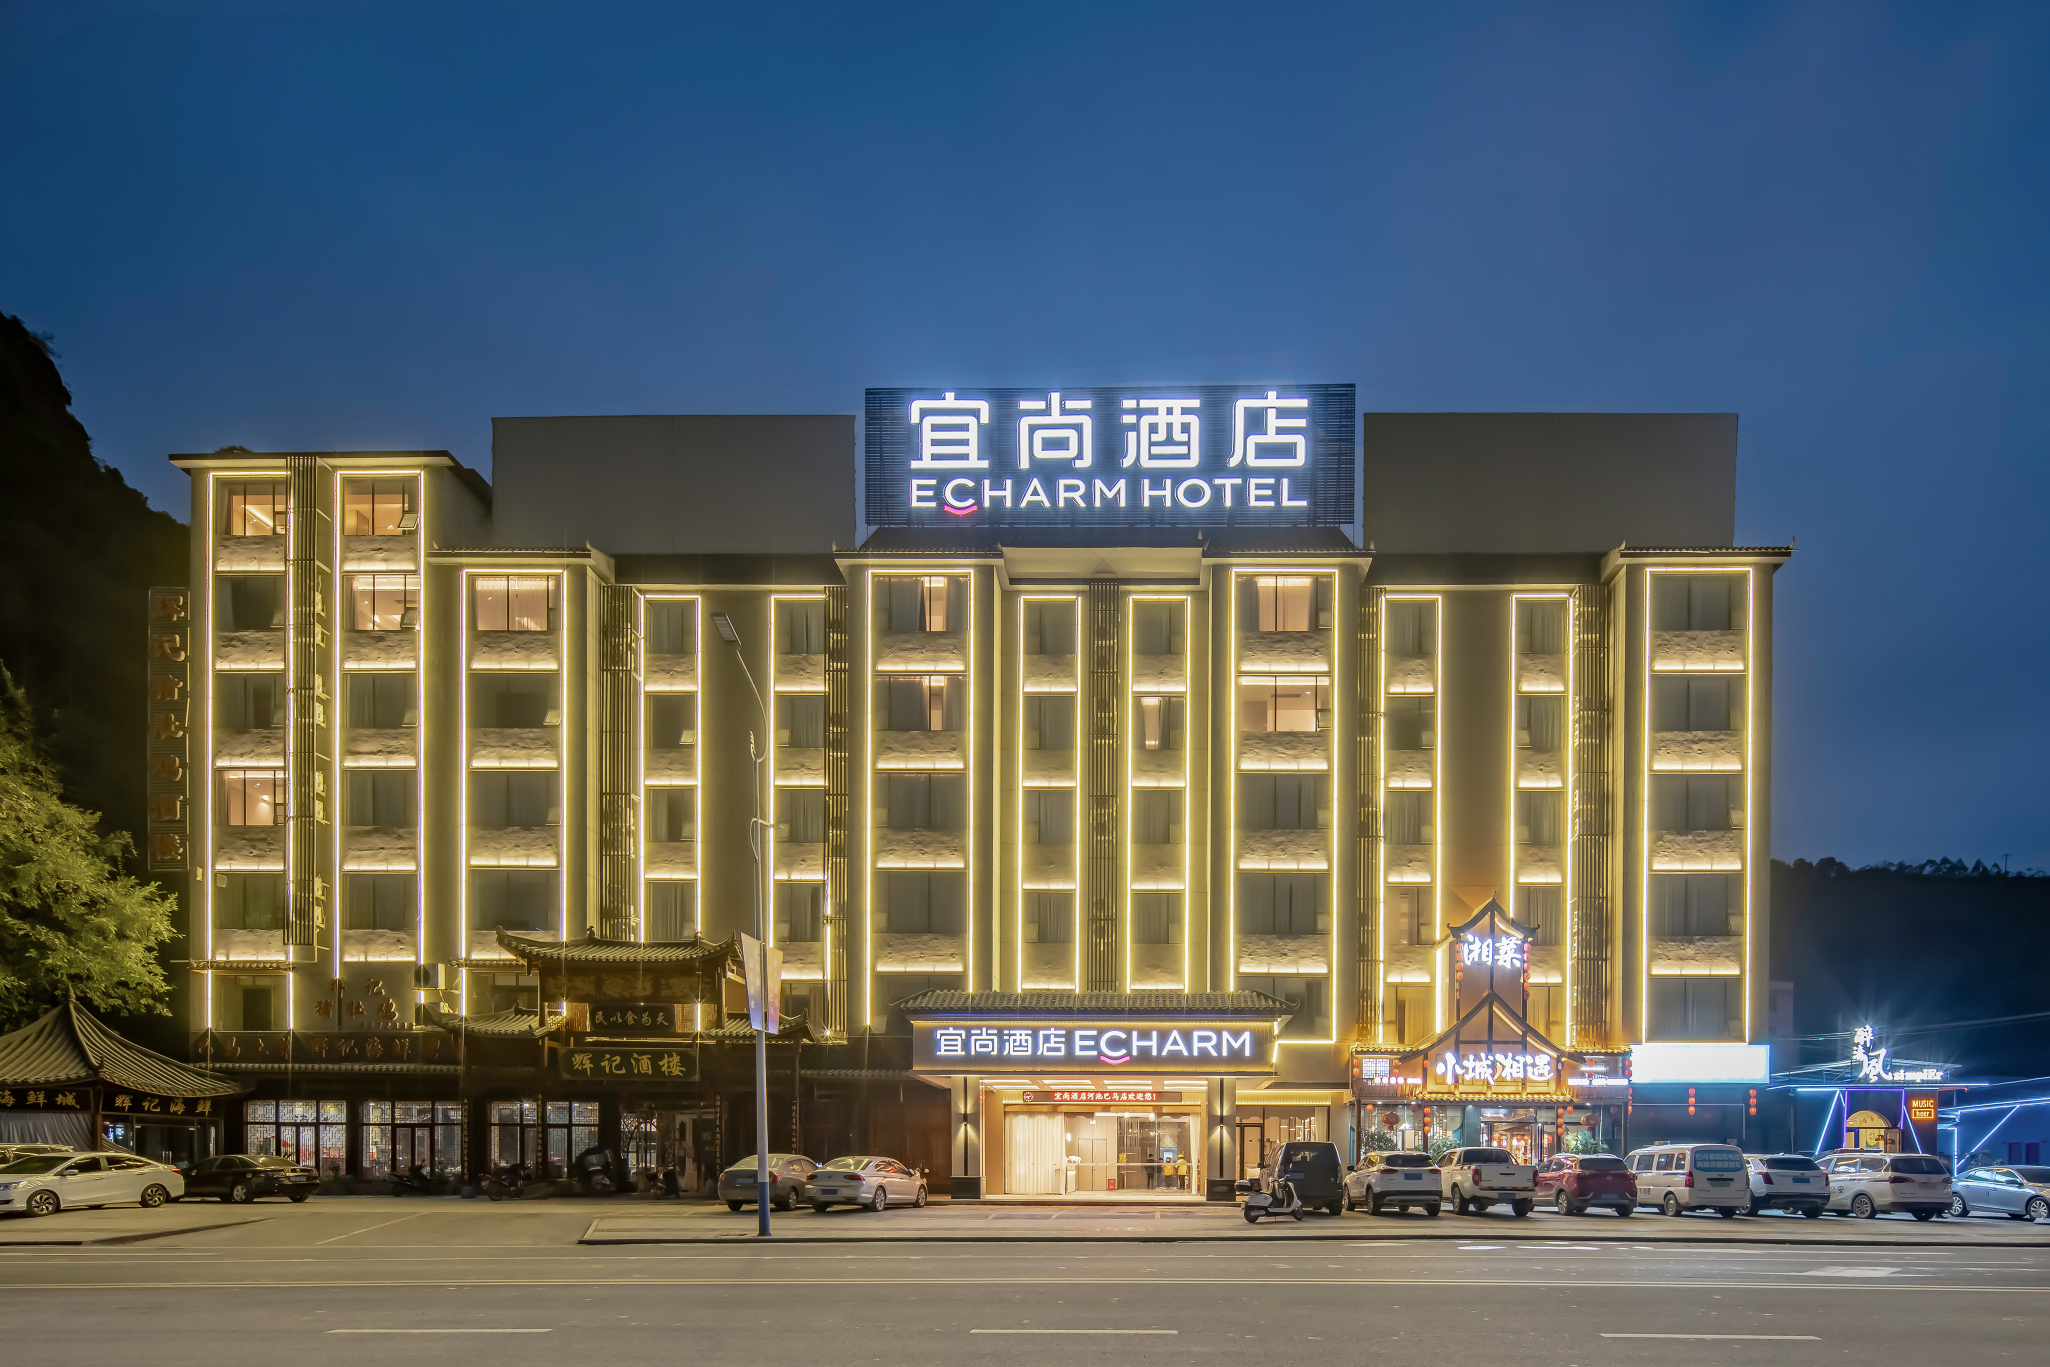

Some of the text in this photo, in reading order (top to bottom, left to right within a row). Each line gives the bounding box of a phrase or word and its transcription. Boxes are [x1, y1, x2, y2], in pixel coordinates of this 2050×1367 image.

[909, 390, 1309, 470] 宜尚酒店
[909, 477, 1309, 509] ECHARM HOTEL
[1463, 933, 1523, 969] 湘菜
[314, 998, 399, 1021] 猪肚鸡
[595, 1010, 670, 1026] 民以食为天
[935, 1026, 1066, 1057] 宜尚酒店
[1074, 1029, 1252, 1058] ECHARM
[571, 1051, 687, 1078] 辉记酒楼
[1435, 1051, 1555, 1086] 小城湘遇
[114, 1094, 213, 1118] 辉记海鲜
[1912, 1099, 1934, 1108] MUSIC
[1830, 1184, 1845, 1194] 公安
